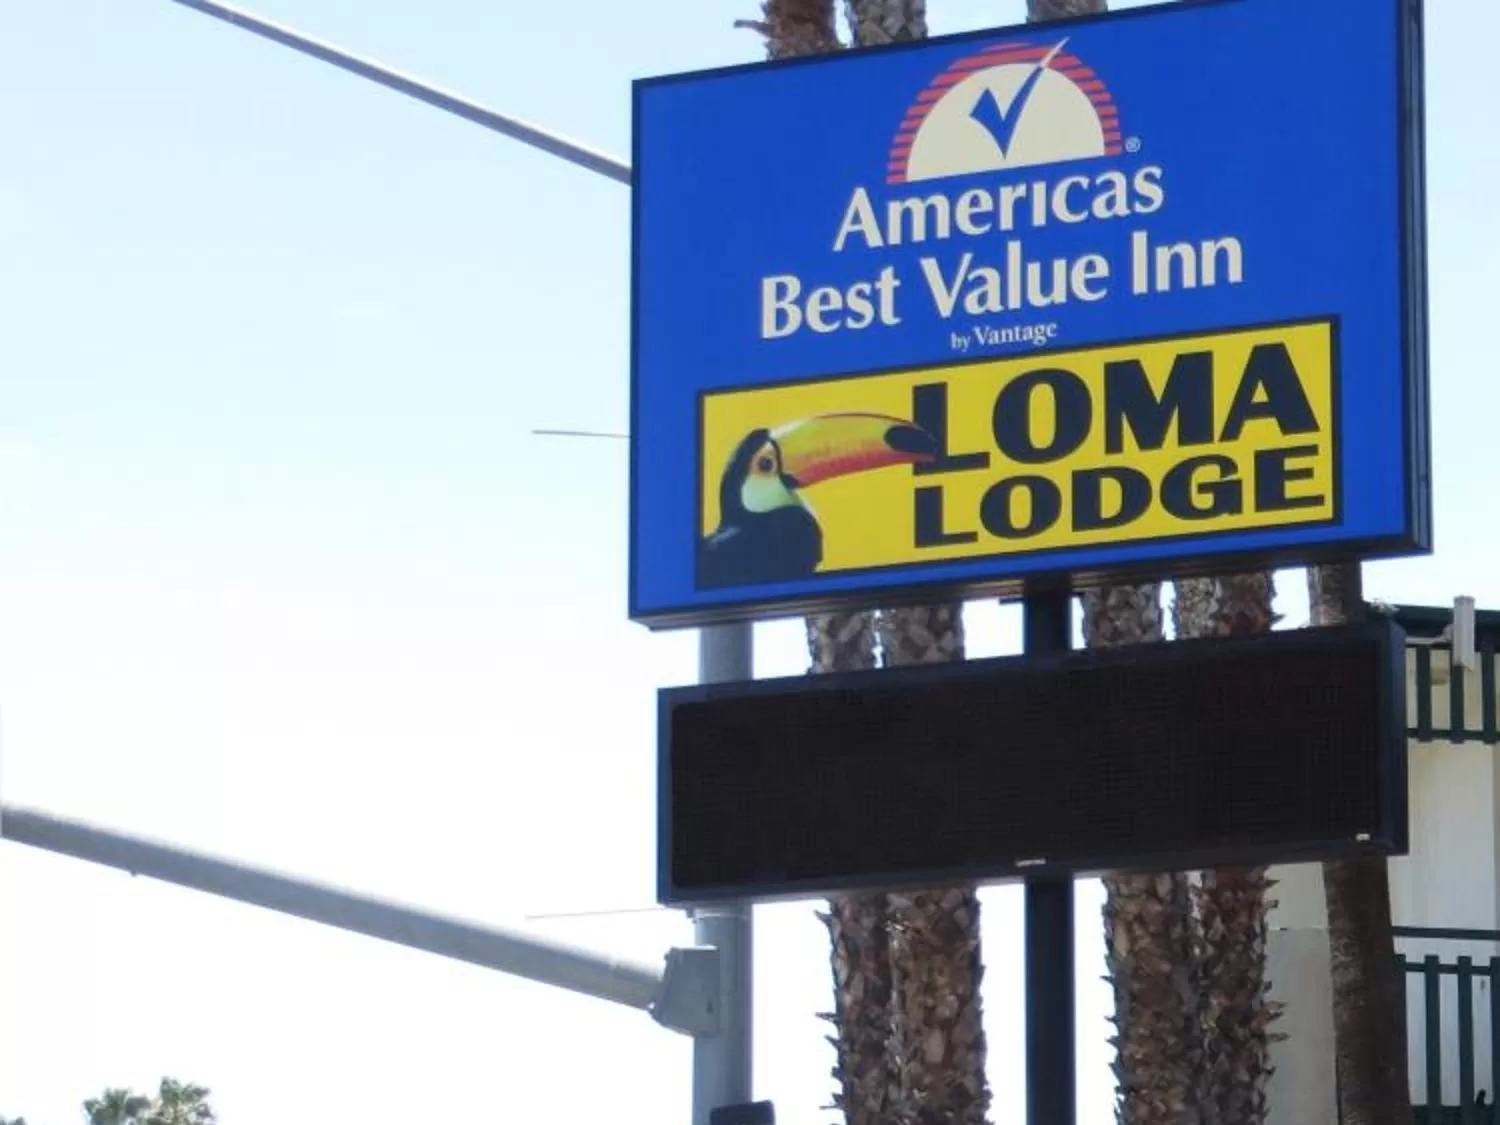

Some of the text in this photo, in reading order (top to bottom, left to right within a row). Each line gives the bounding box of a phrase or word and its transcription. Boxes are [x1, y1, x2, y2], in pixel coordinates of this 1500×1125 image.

[832, 165, 1165, 252] Americas
[761, 229, 1244, 340] Best Value Inn
[950, 322, 1058, 353] by Vantage
[912, 341, 1321, 476] LOMA
[913, 443, 1326, 549] LODGE
